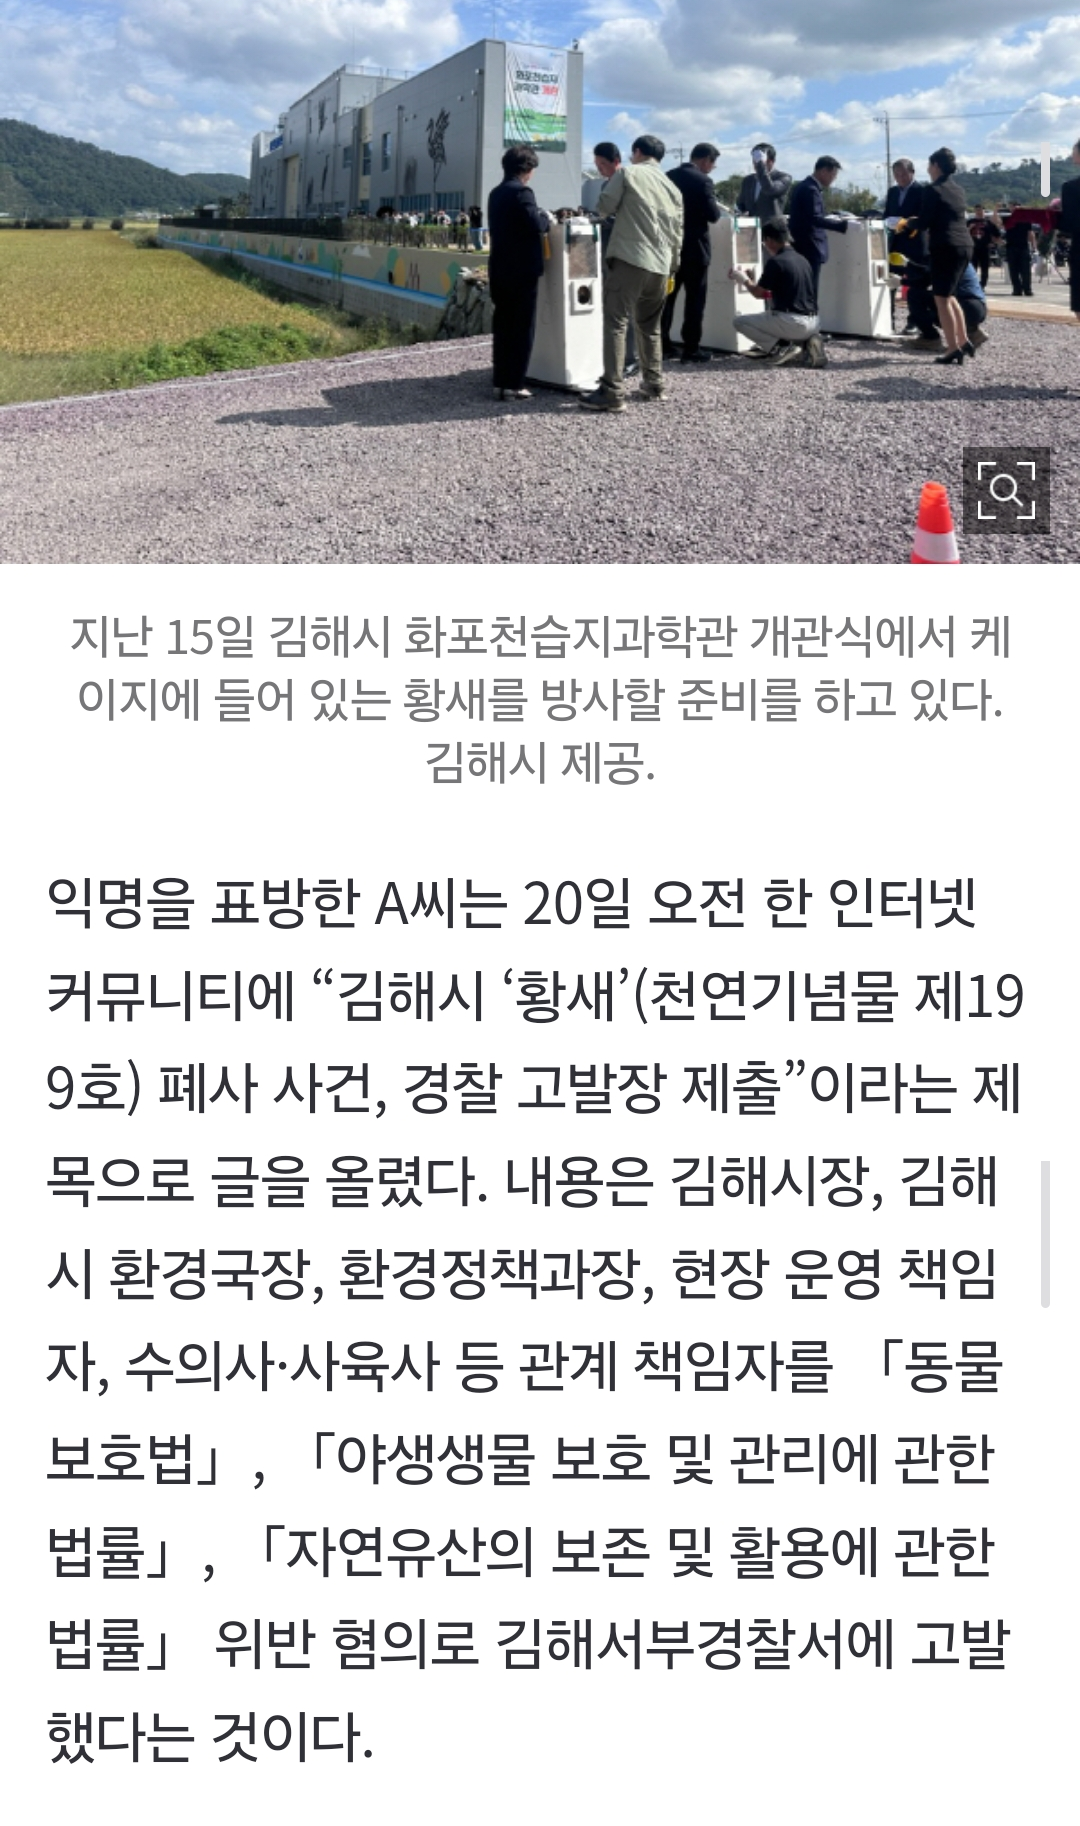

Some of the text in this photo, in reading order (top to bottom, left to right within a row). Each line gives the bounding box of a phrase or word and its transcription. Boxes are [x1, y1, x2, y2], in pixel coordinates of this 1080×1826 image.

[71, 615, 1009, 658] 지난 15일 김해시 화포천습지과학관 개관식에서 케
[79, 679, 1001, 722] 이지에 들어 있는 황새를 방사할 준비를 하고 있다.
[427, 742, 654, 785] 김해시 제공.
[49, 878, 975, 929] 익명을 표방한 A씨는 20일 오전 한 인터넷
[49, 967, 1023, 1024] 커뮤니티에 “김해시 ‘황새’(천연기념물 제19
[47, 1059, 1018, 1119] 9호) 폐사 사건, 경찰 고발장 제출”이라는 제
[47, 1156, 995, 1211] 목으로 글을 올렸다. 내용은 김해시장, 김해
[48, 1249, 994, 1304] 시 환경국장, 환경정책과장, 현장 운영 책임
[46, 1339, 1003, 1396] 자, 수의사·사육사 등 관계 책임자를 「동물
[317, 1432, 535, 1485] 「야생생물
[552, 1435, 650, 1480] 보호
[670, 1434, 713, 1484] 및
[730, 1434, 876, 1484] 관리에
[895, 1434, 995, 1484] 관한
[267, 1525, 531, 1578] 「자연유산의
[552, 1528, 650, 1577] 보존
[670, 1527, 713, 1577] 및
[730, 1527, 876, 1579] 활용에
[895, 1527, 995, 1577] 관한
[50, 1619, 1010, 1671] 법률」 위반 혐의로 김해서부경찰서에 고발
[47, 1712, 372, 1764] 했다는 것이다.
